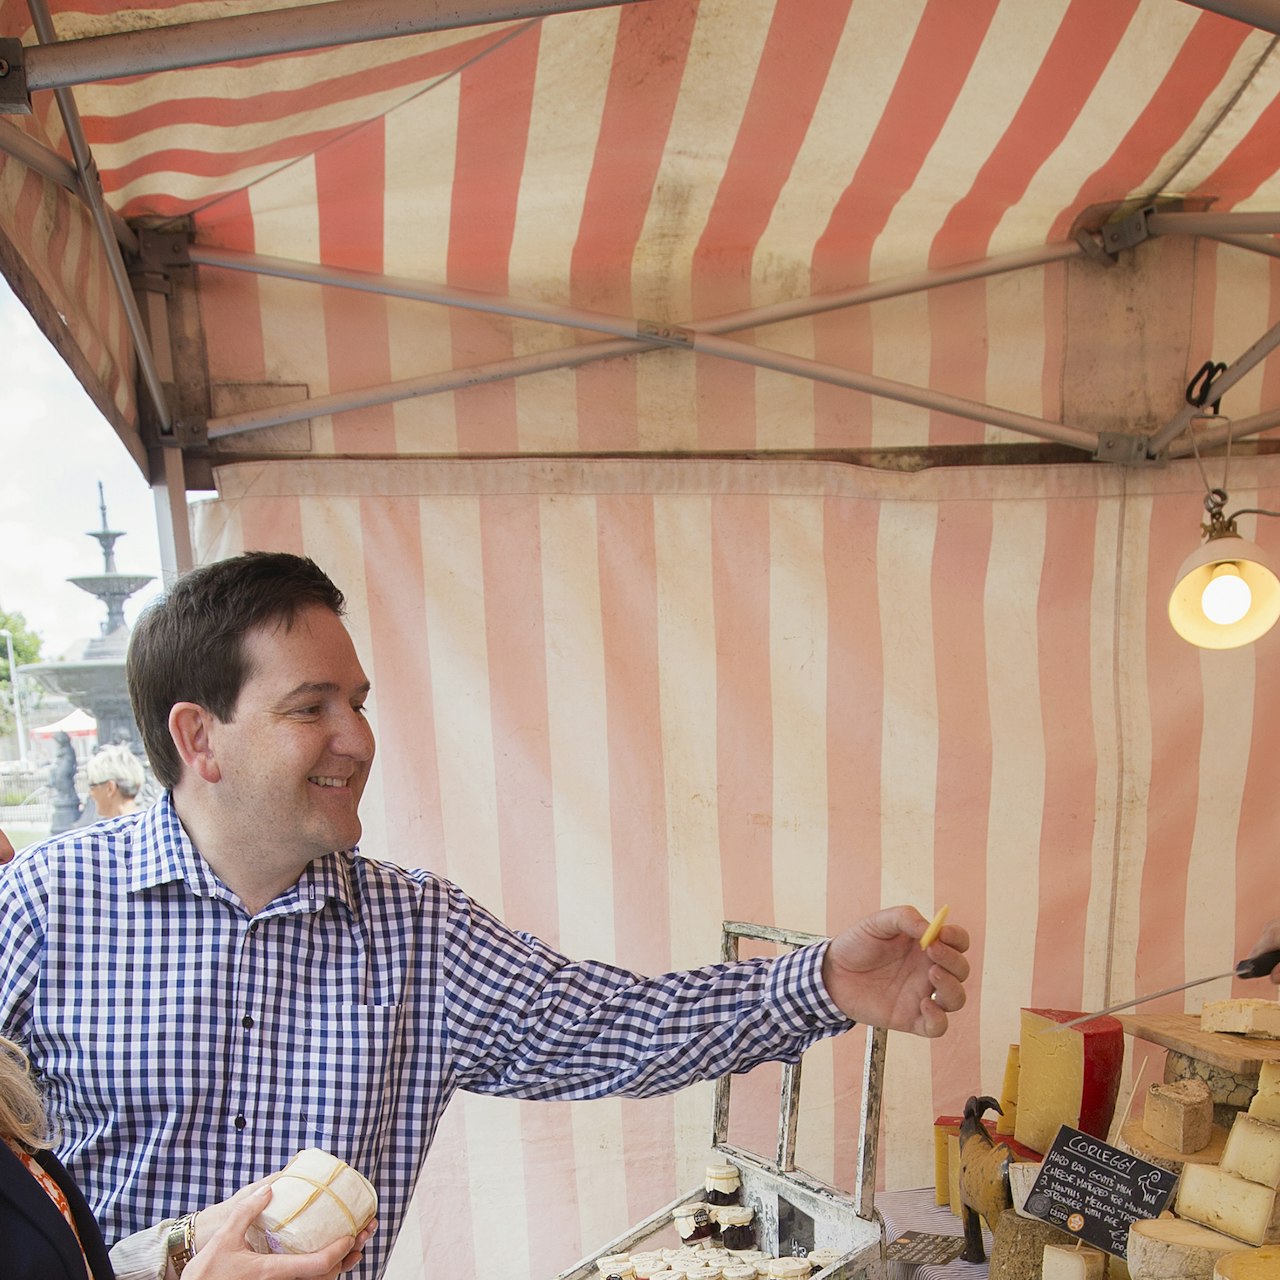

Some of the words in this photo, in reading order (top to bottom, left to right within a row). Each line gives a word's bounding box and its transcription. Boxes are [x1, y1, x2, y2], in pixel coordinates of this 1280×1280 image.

[1049, 1151, 1069, 1166] HARD
[1072, 1161, 1086, 1173] RAW
[1069, 1136, 1136, 1173] CORLEGGY
[1040, 1176, 1048, 1186] 2
[1085, 1196, 1115, 1213] MELLOW
[1044, 1189, 1083, 1210] STRONGER
[1111, 1194, 1123, 1205] FOR
[1050, 1207, 1068, 1221] taste
